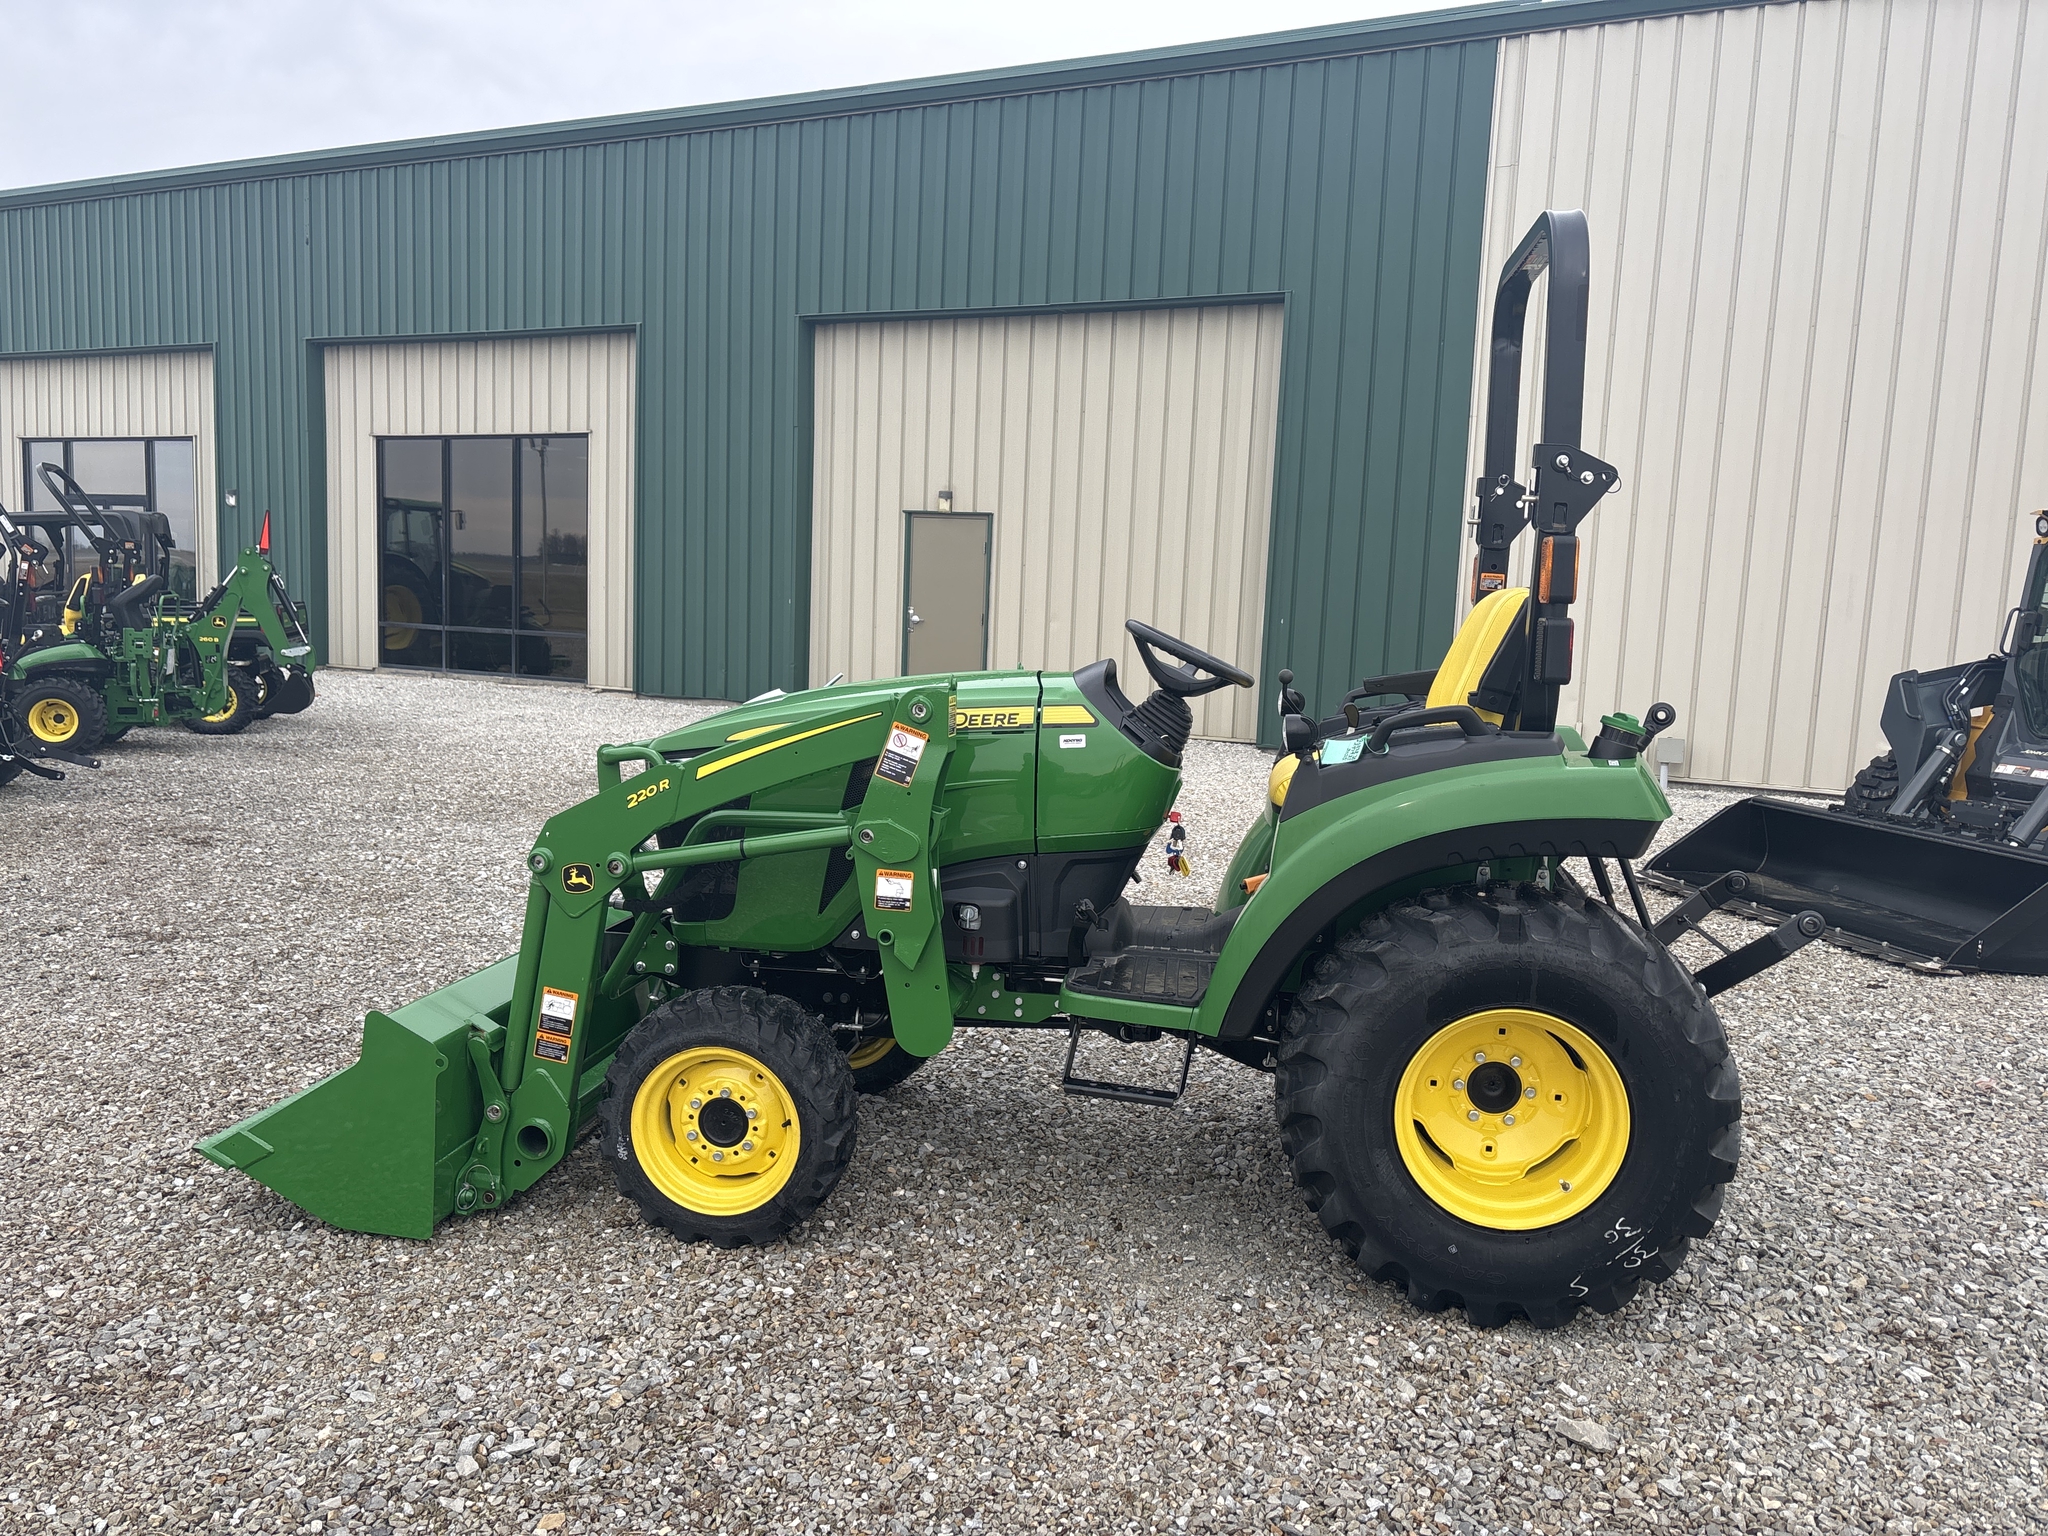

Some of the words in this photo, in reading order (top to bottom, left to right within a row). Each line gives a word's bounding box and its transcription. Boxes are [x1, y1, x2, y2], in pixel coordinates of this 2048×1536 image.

[956, 711, 1020, 728] DEERE
[900, 724, 927, 740] WARNING
[883, 871, 912, 879] WARNING
[552, 990, 574, 999] WARNING
[545, 1034, 567, 1044] WARNING
